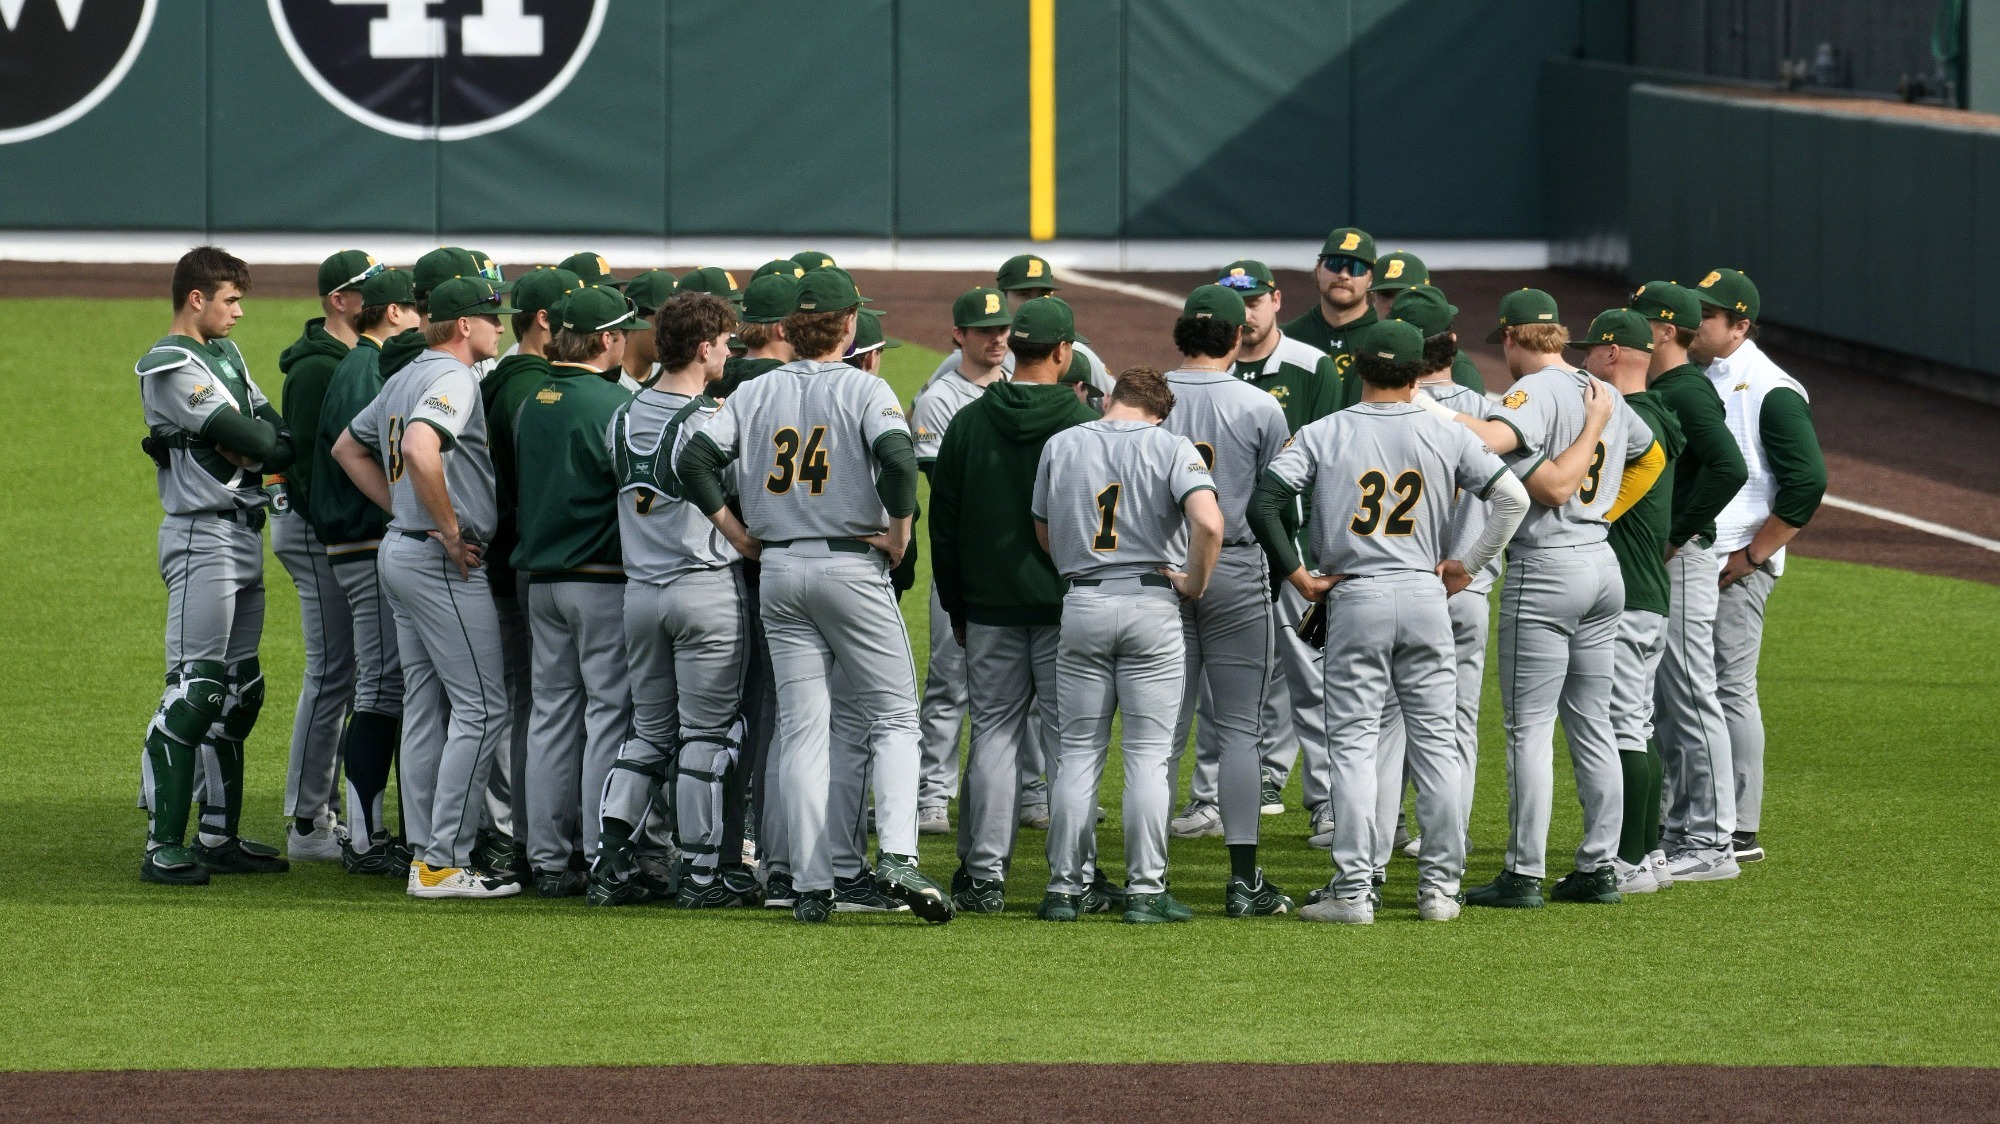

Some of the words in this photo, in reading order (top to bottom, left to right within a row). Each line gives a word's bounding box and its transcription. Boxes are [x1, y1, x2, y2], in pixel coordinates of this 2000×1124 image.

[1339, 232, 1361, 251] B
[1027, 259, 1043, 278] B
[1383, 259, 1405, 279] B
[1698, 270, 1721, 289] B
[984, 293, 1000, 315] B
[423, 398, 457, 417] SUMMIT
[765, 425, 831, 496] 34
[1348, 468, 1423, 536] 32
[1093, 482, 1121, 552] 1
